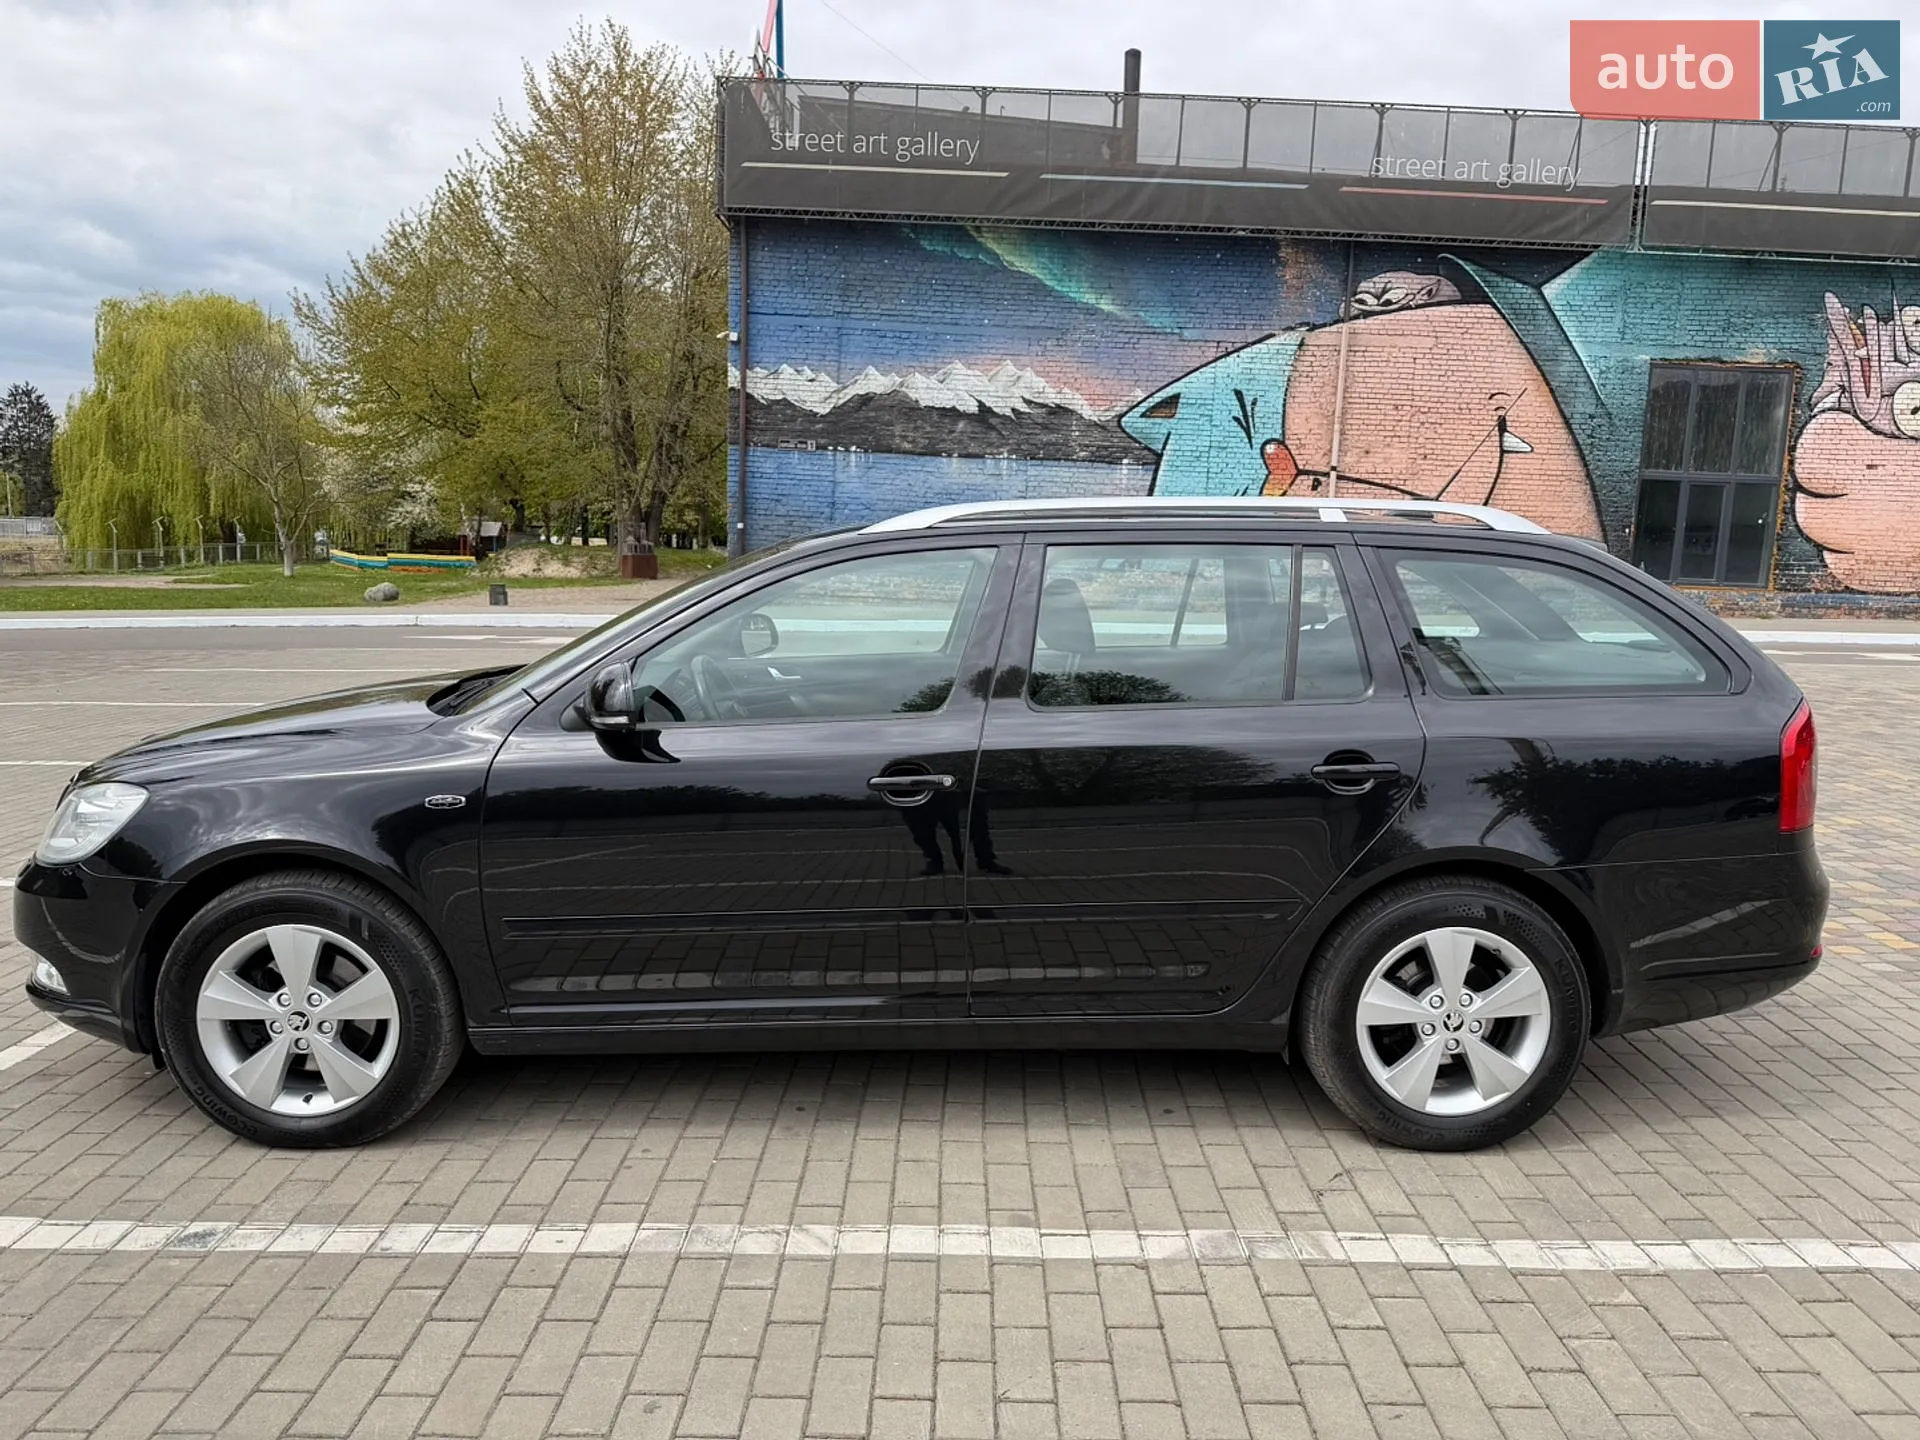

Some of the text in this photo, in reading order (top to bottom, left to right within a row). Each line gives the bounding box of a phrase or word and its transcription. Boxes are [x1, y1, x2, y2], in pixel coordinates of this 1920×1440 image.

[770, 130, 980, 165] street art gallery
[1371, 156, 1582, 192] street art gallery
